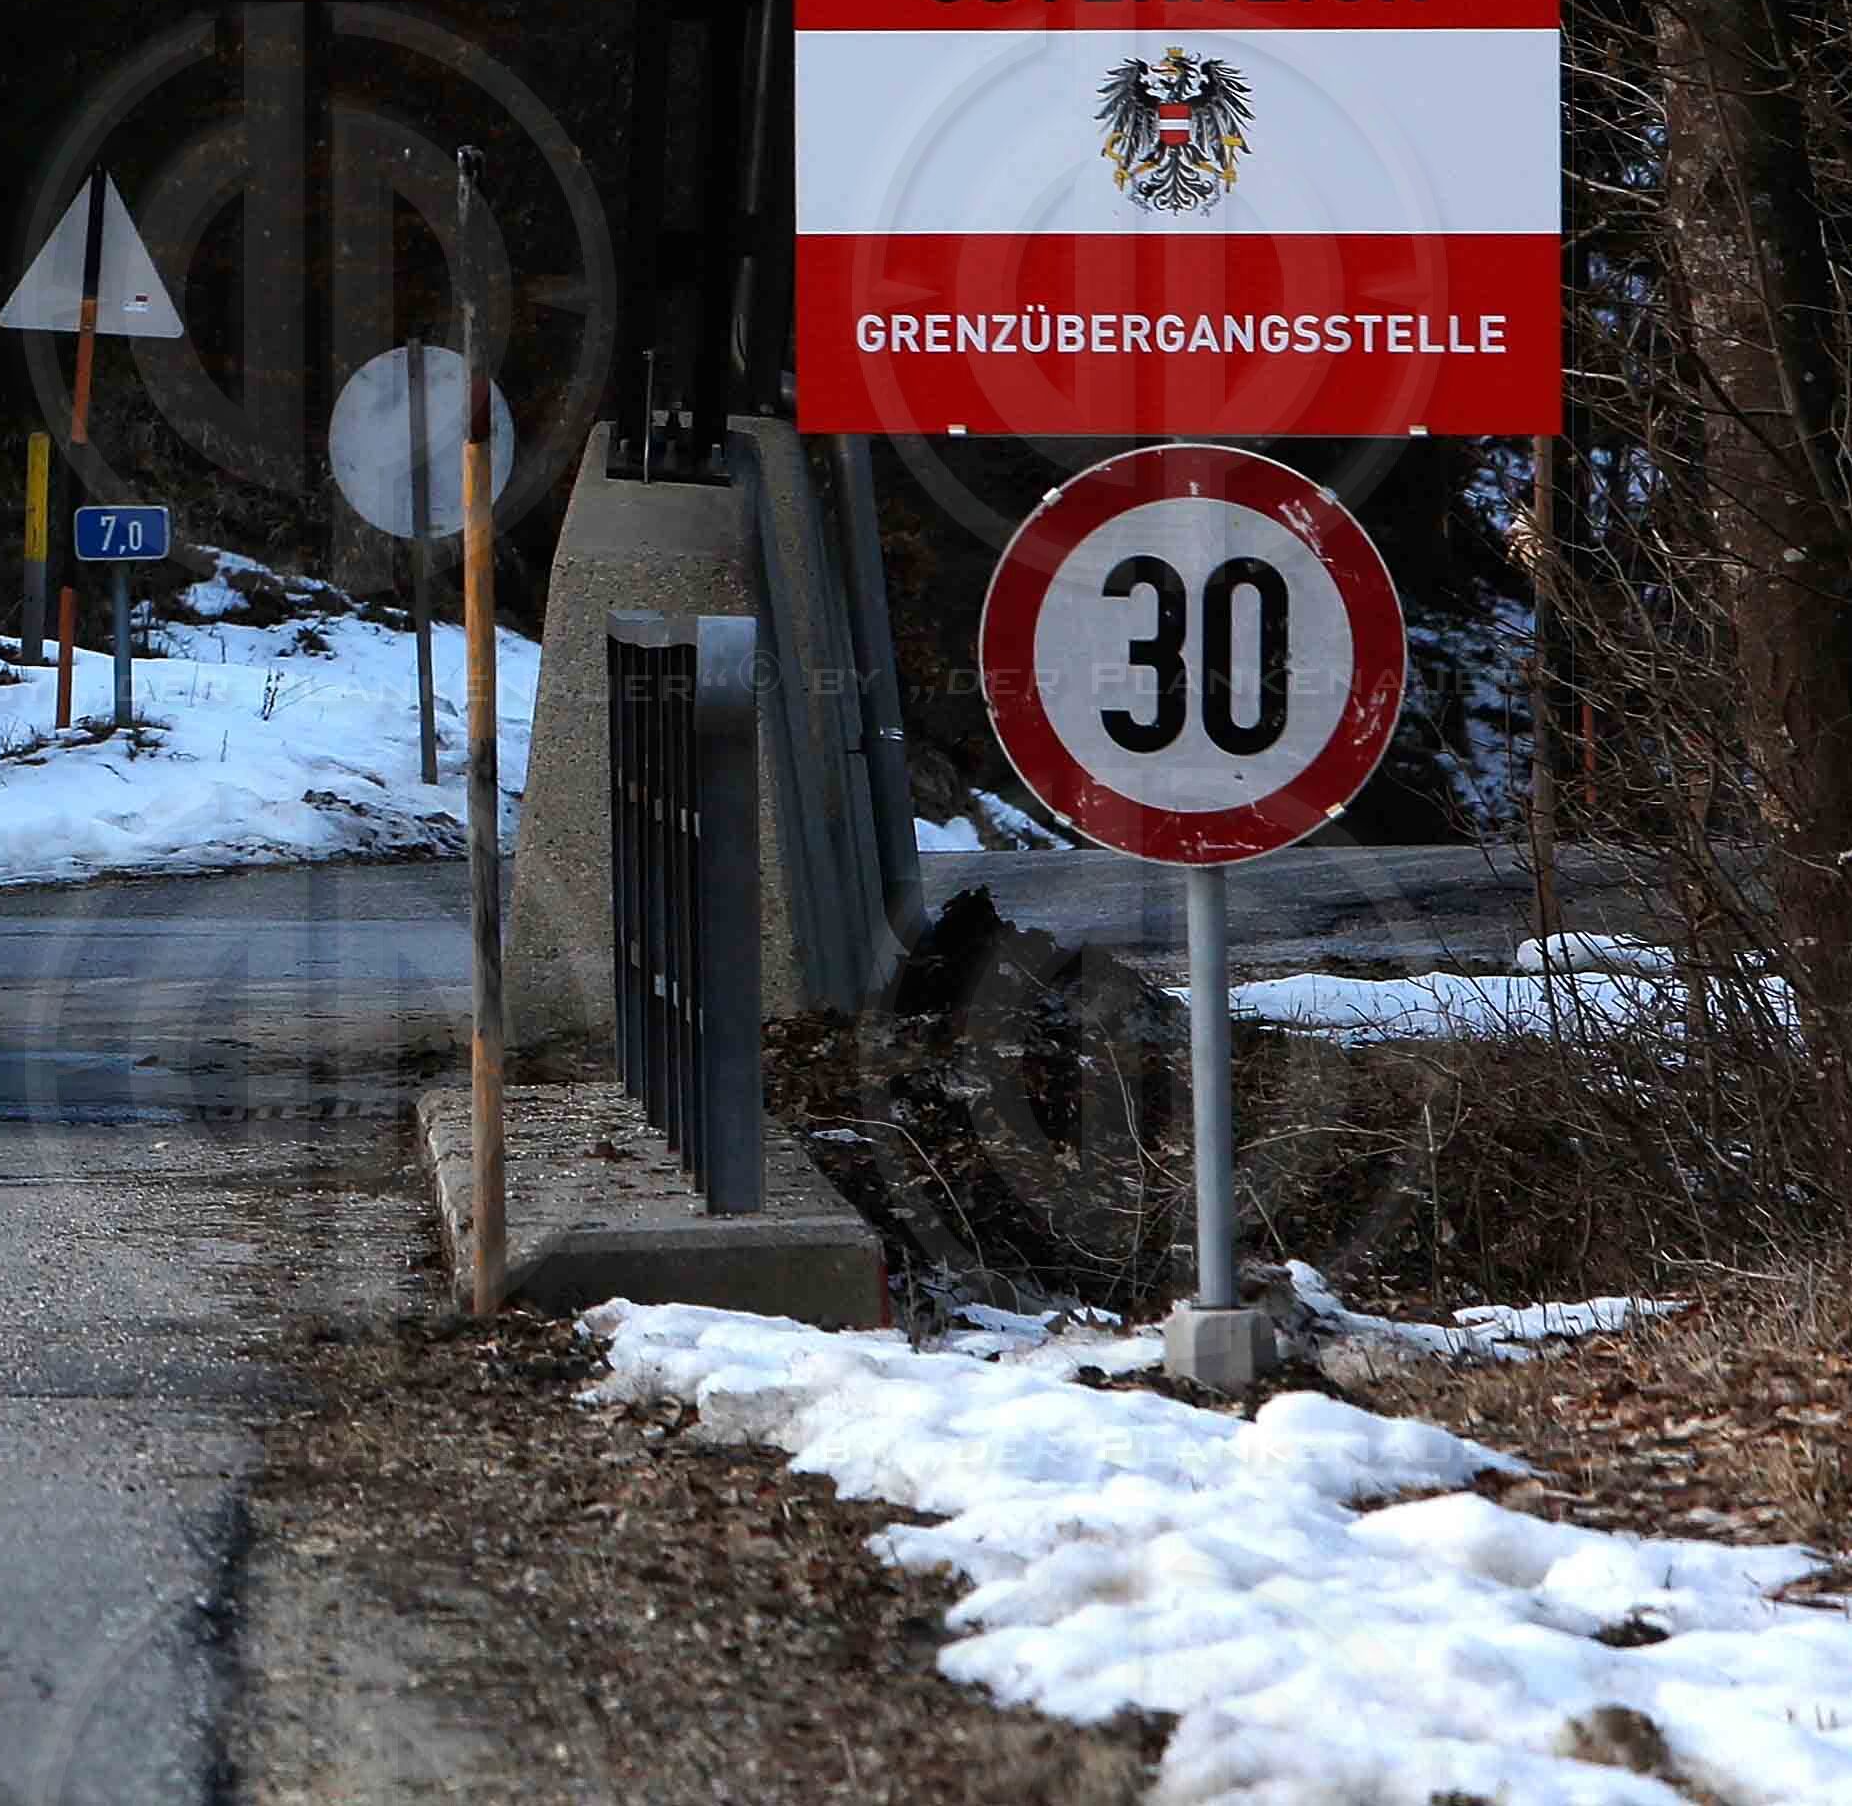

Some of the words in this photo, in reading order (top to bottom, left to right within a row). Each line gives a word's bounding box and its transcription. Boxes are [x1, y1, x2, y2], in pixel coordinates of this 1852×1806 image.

[856, 305, 1508, 354] GRENZÜBERGANGSSTELLE
[99, 514, 143, 554] 7,0
[1101, 555, 1289, 755] 30
